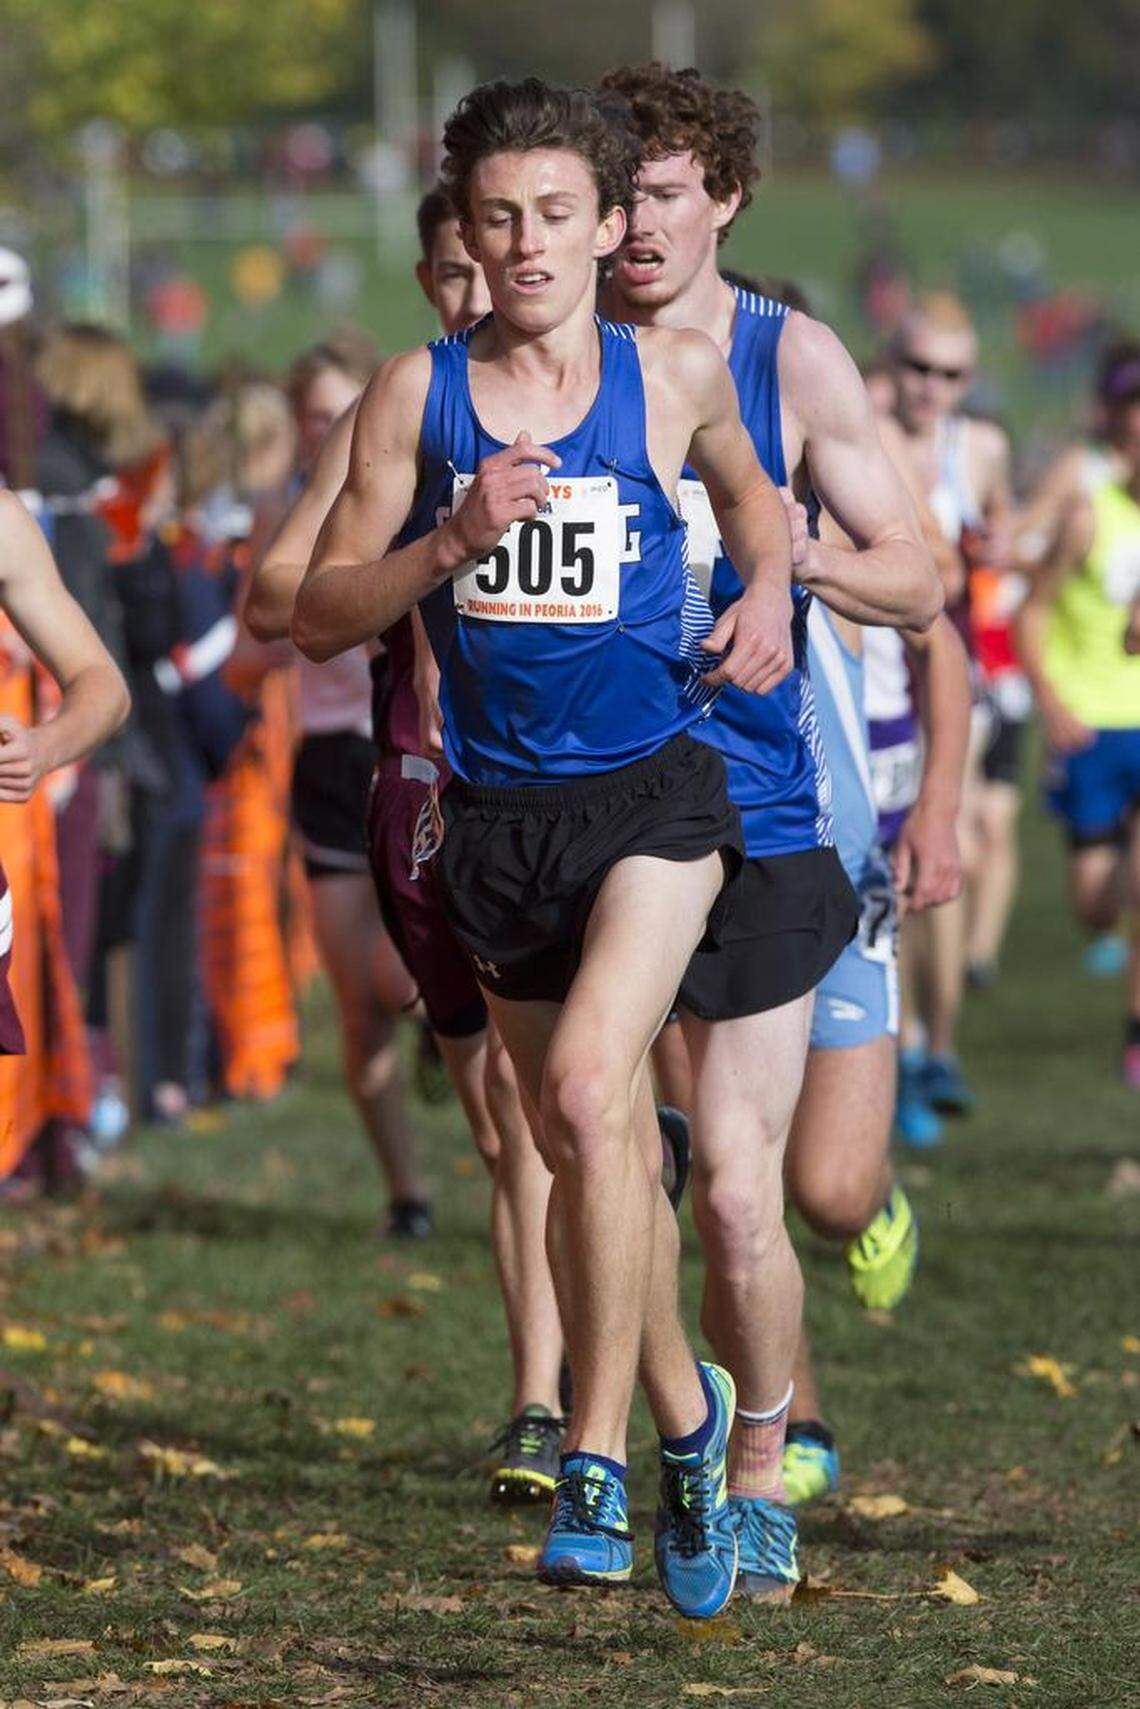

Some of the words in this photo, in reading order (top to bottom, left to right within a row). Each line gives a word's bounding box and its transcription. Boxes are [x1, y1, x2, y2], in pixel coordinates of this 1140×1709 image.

[476, 519, 595, 596] 505
[467, 600, 517, 616] RUNNING
[519, 603, 532, 616] IN
[535, 604, 576, 617] PEORIA
[580, 603, 603, 617] 2016
